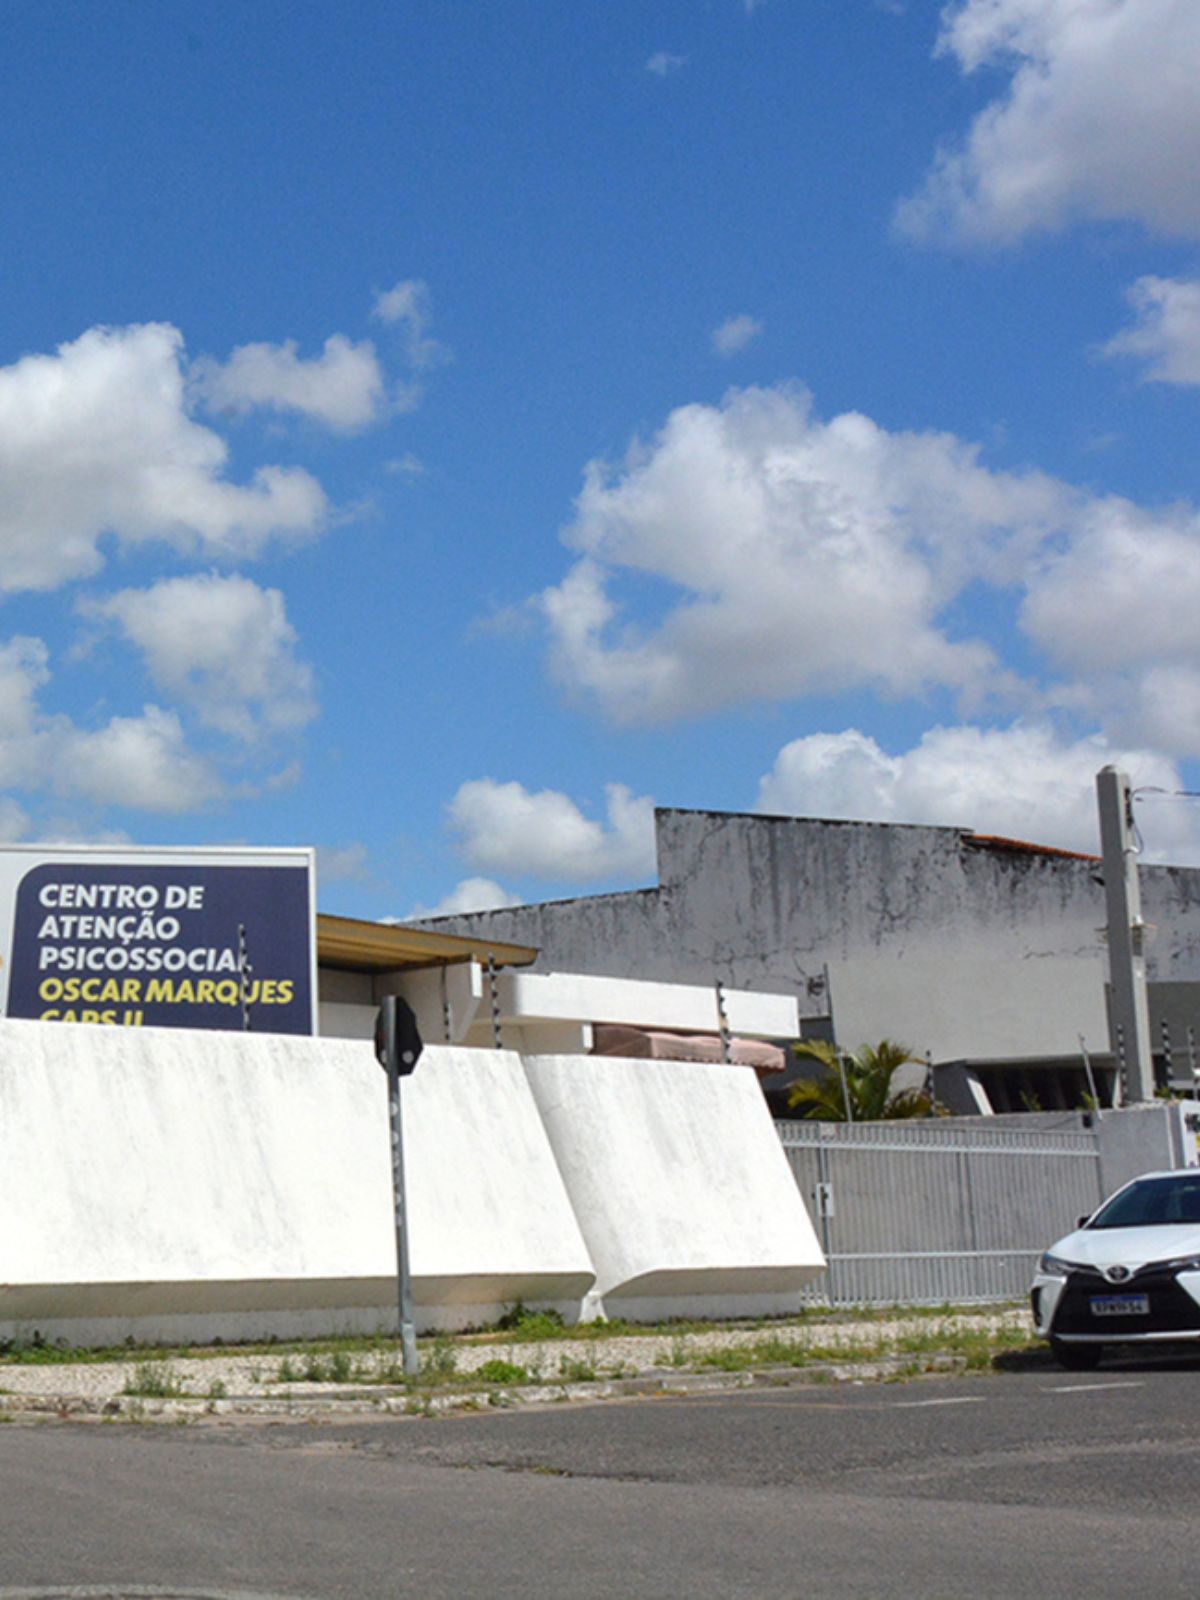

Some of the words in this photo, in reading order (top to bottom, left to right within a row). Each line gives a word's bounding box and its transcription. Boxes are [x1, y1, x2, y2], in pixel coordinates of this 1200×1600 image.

[38, 884, 159, 909] CENTRO
[164, 885, 205, 910] DE
[38, 910, 180, 945] ATENÇÃO
[38, 946, 253, 972] PSICOSSOCIAL
[38, 977, 141, 1003] OSCAR
[144, 978, 294, 1006] MARQUES
